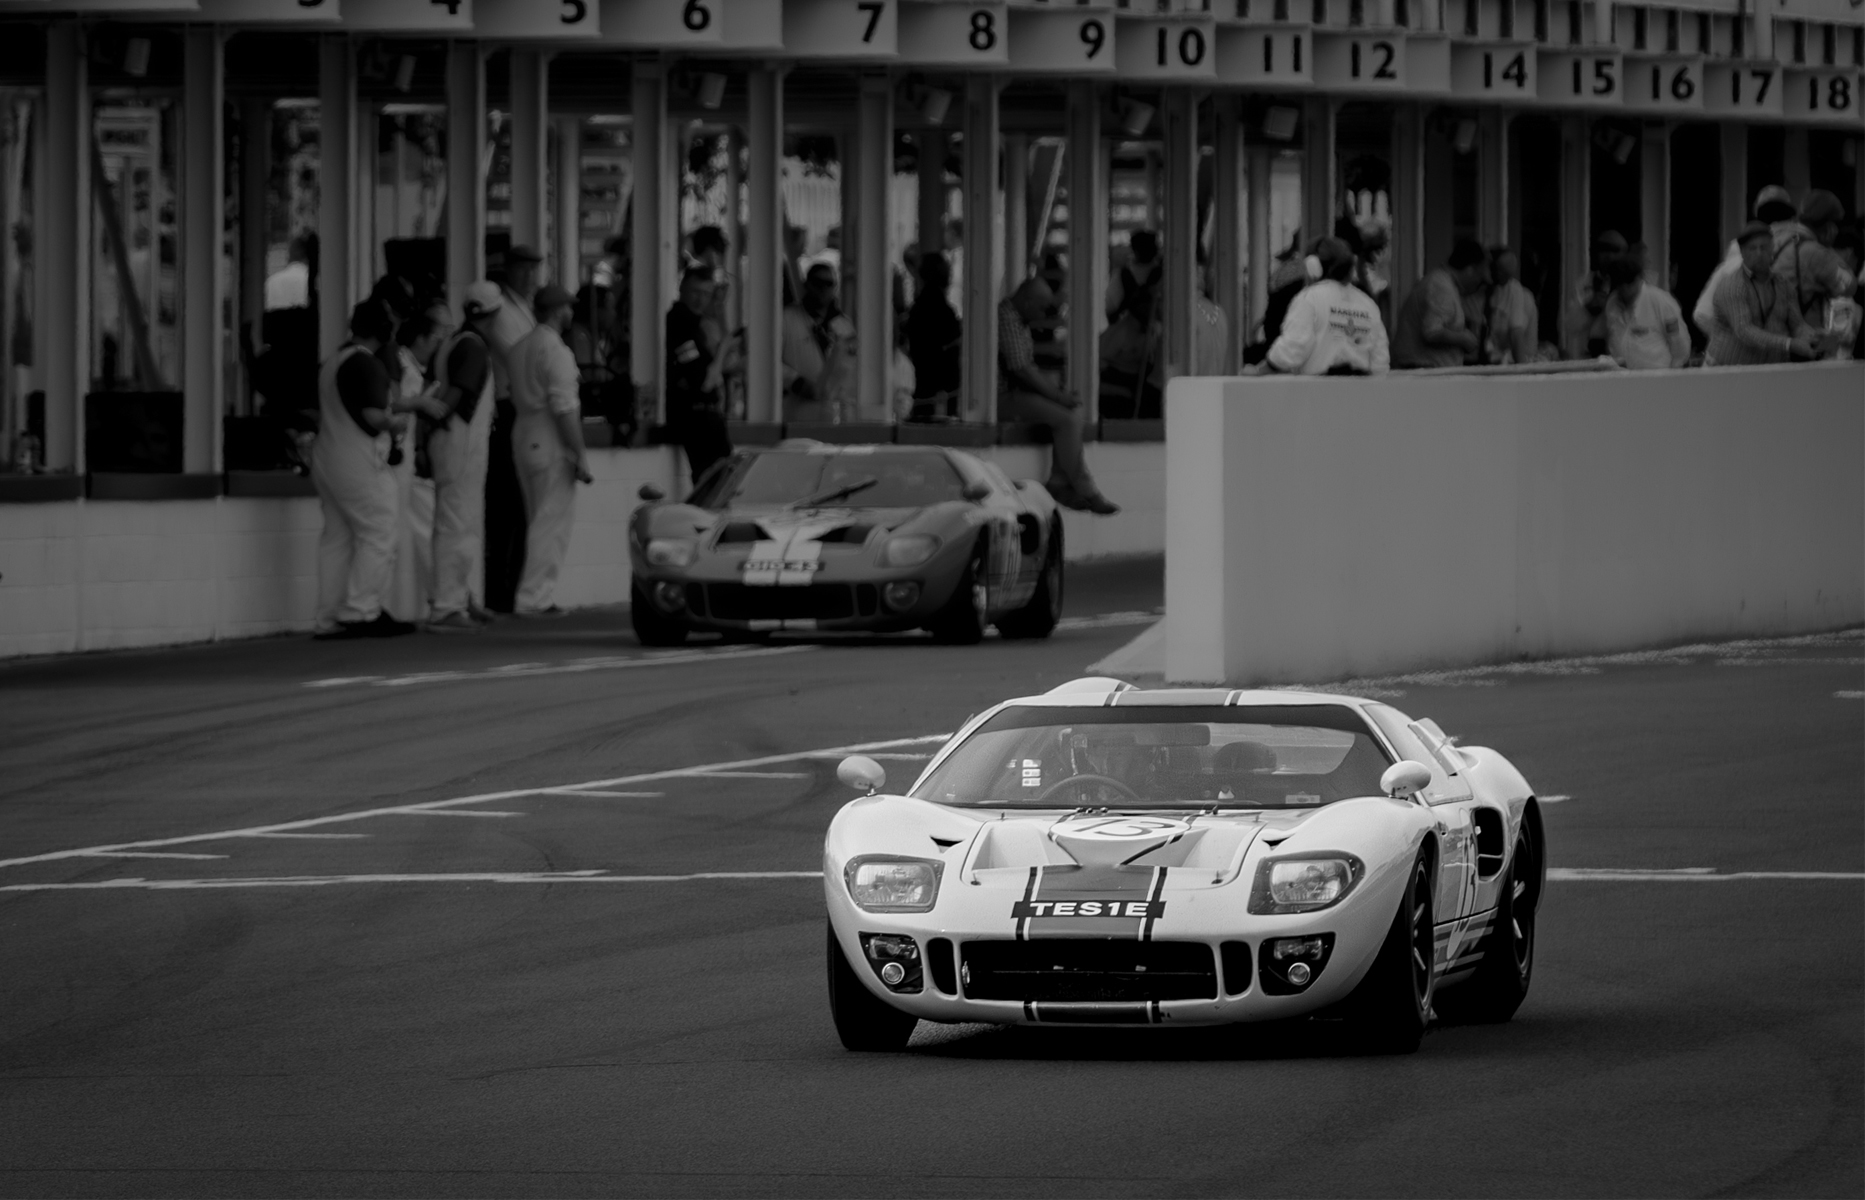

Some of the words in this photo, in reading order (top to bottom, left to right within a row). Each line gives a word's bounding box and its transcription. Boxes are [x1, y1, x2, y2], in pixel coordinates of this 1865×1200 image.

[684, 0, 709, 30] 6
[858, 3, 882, 42] 7
[970, 11, 994, 50] 8
[1081, 21, 1103, 57] 9
[1158, 28, 1204, 65] 10
[1264, 36, 1300, 71] 11
[1352, 43, 1394, 78] 12
[1484, 53, 1525, 87] 14
[1573, 60, 1613, 93] 15
[1653, 67, 1693, 99] 16
[1732, 70, 1772, 103] 17
[1810, 76, 1849, 109] 18
[1072, 818, 1176, 837] 13
